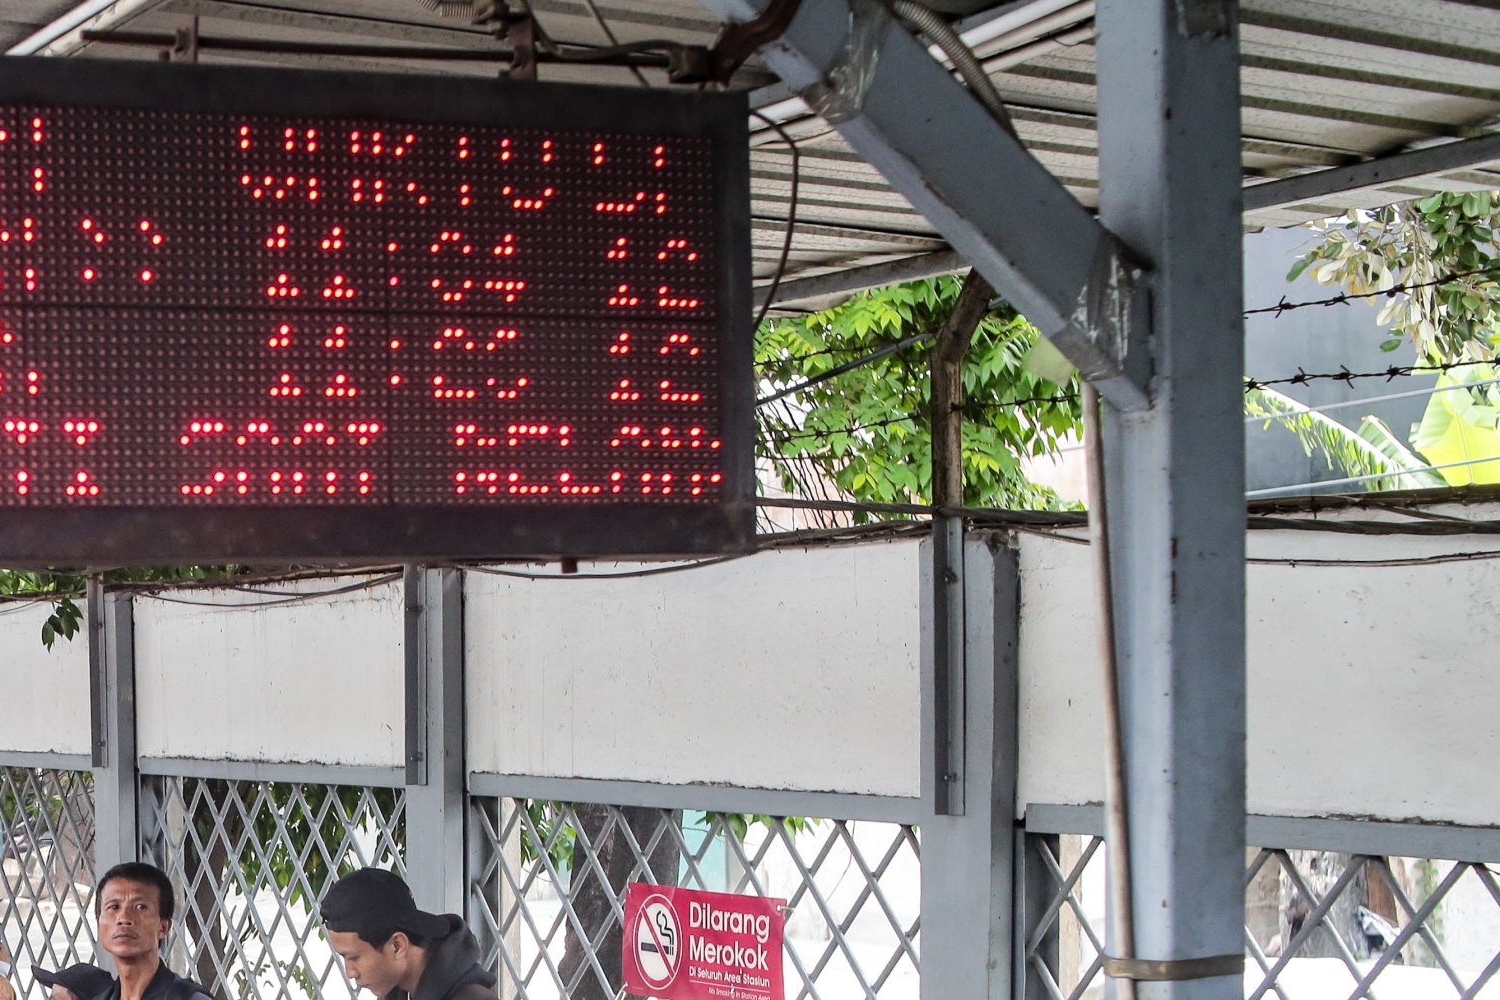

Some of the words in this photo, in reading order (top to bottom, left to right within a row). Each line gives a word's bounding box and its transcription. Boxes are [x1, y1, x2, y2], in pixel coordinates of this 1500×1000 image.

[689, 901, 770, 944] Dilarang
[689, 935, 769, 971] Merokok
[697, 967, 723, 981] Seluruh
[724, 971, 741, 984] Area
[743, 974, 770, 988] Stasiun
